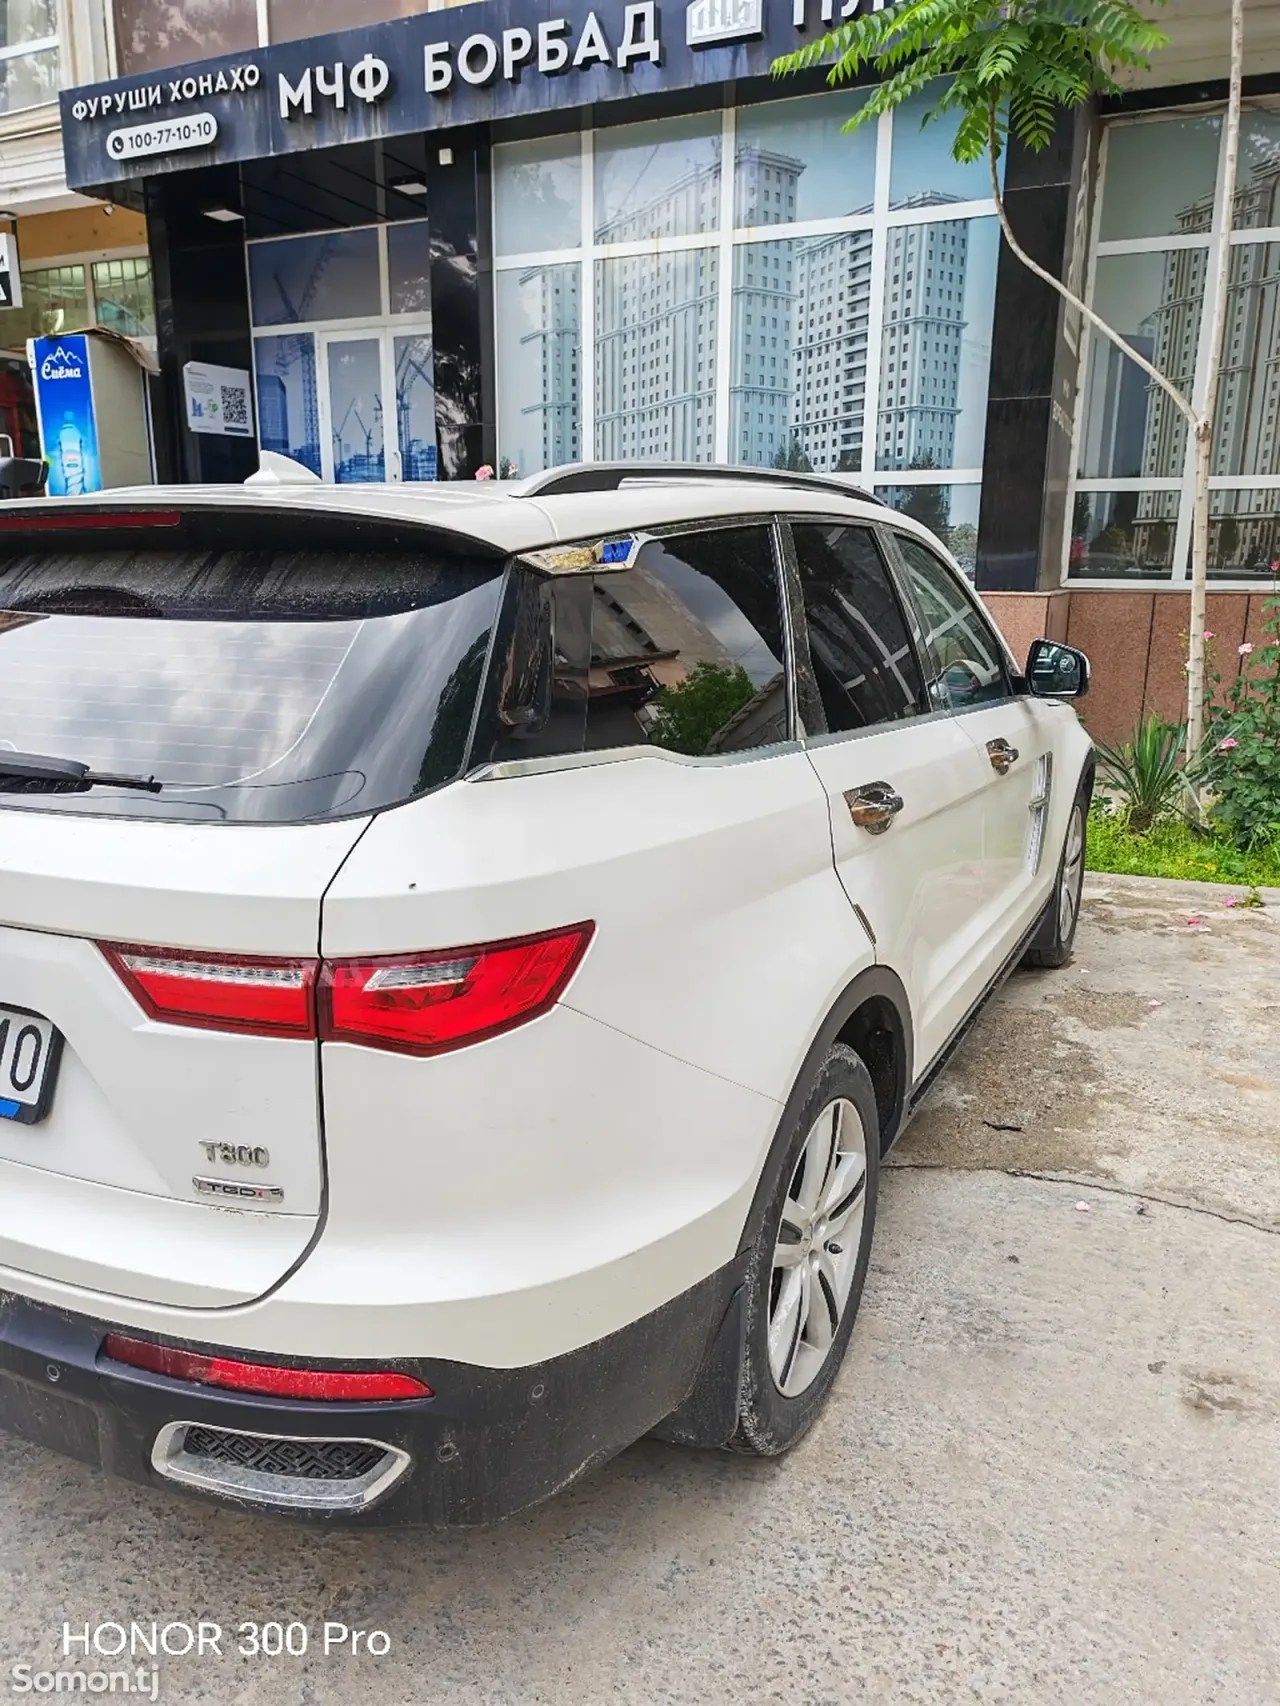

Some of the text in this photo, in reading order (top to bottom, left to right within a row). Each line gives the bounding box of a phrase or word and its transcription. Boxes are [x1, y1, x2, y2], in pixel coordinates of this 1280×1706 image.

[278, 1, 660, 119] МЧФ БОРБАД
[71, 64, 260, 121] ФУРУШИ ХОНАҲО
[128, 120, 212, 150] 100-77-10-10
[198, 1138, 270, 1169] T800
